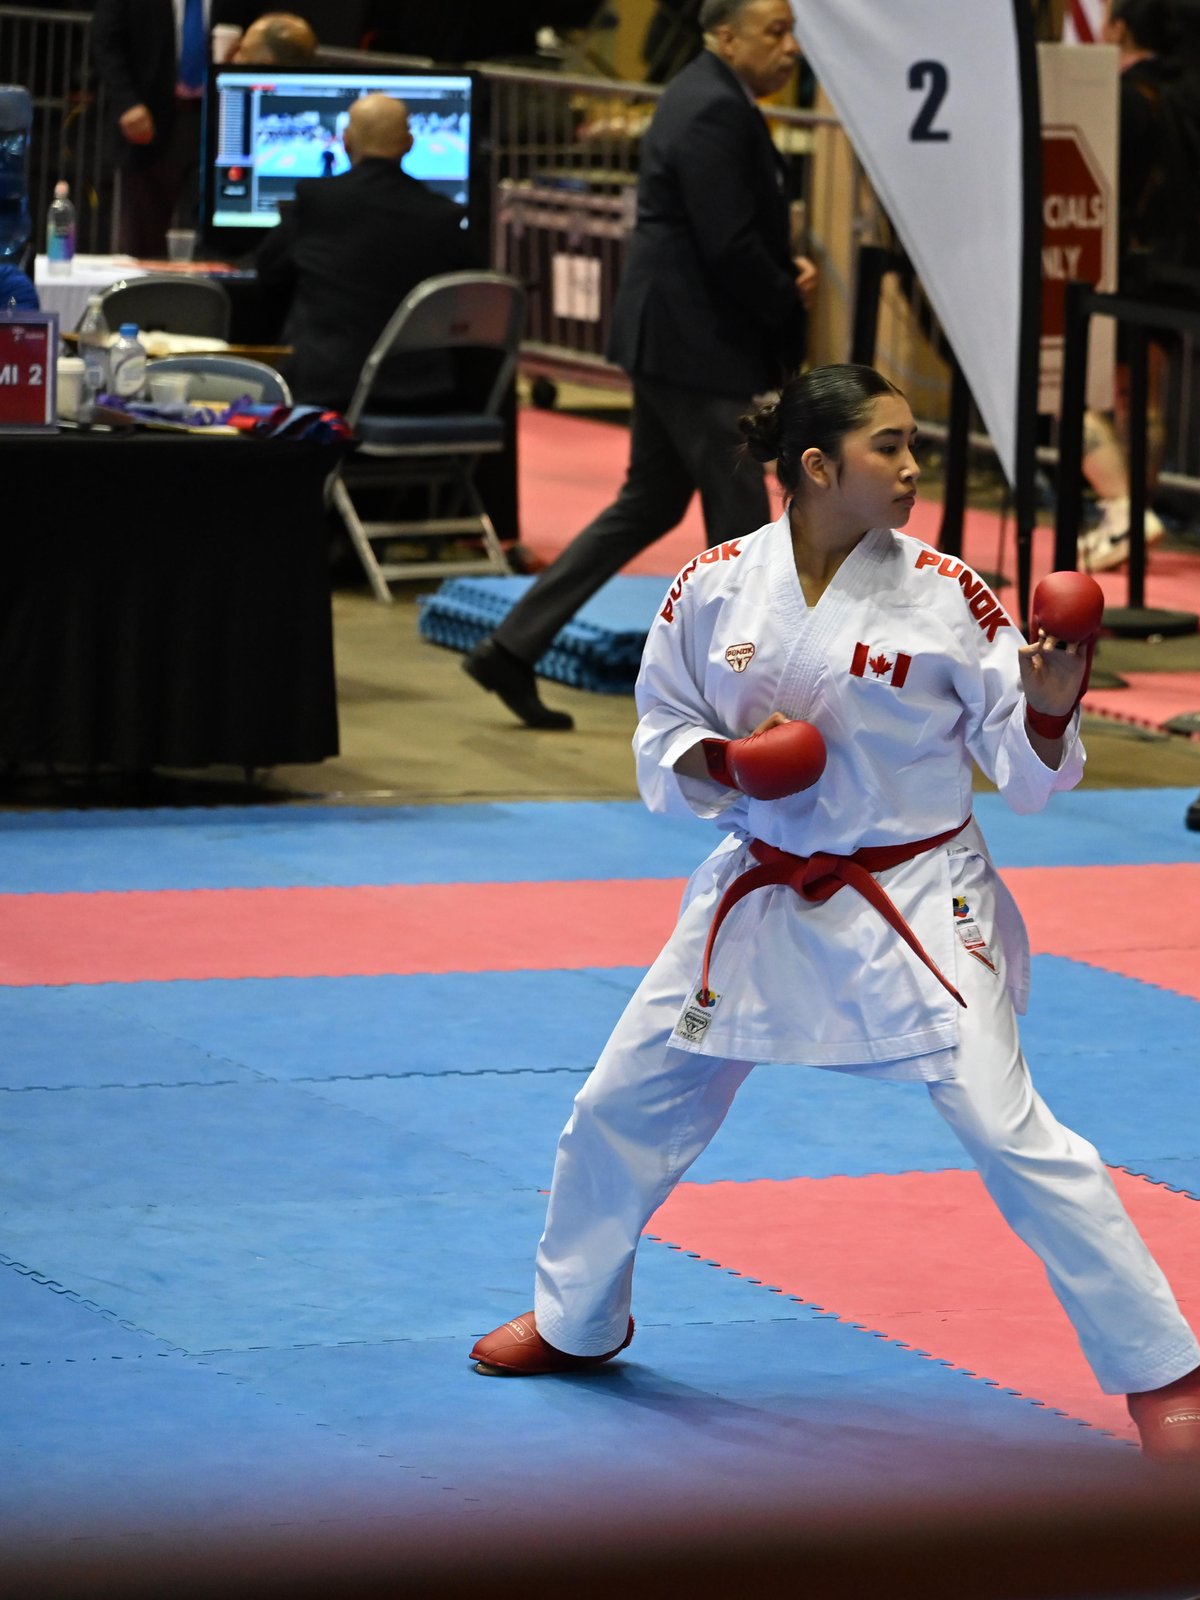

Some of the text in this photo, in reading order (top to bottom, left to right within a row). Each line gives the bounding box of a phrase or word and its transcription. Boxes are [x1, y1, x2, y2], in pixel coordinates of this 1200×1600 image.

[907, 60, 950, 142] 2
[1044, 195, 1105, 229] CIALS
[28, 364, 42, 386] 2
[660, 539, 742, 624] PUNOK
[914, 549, 1011, 643] PUNOK
